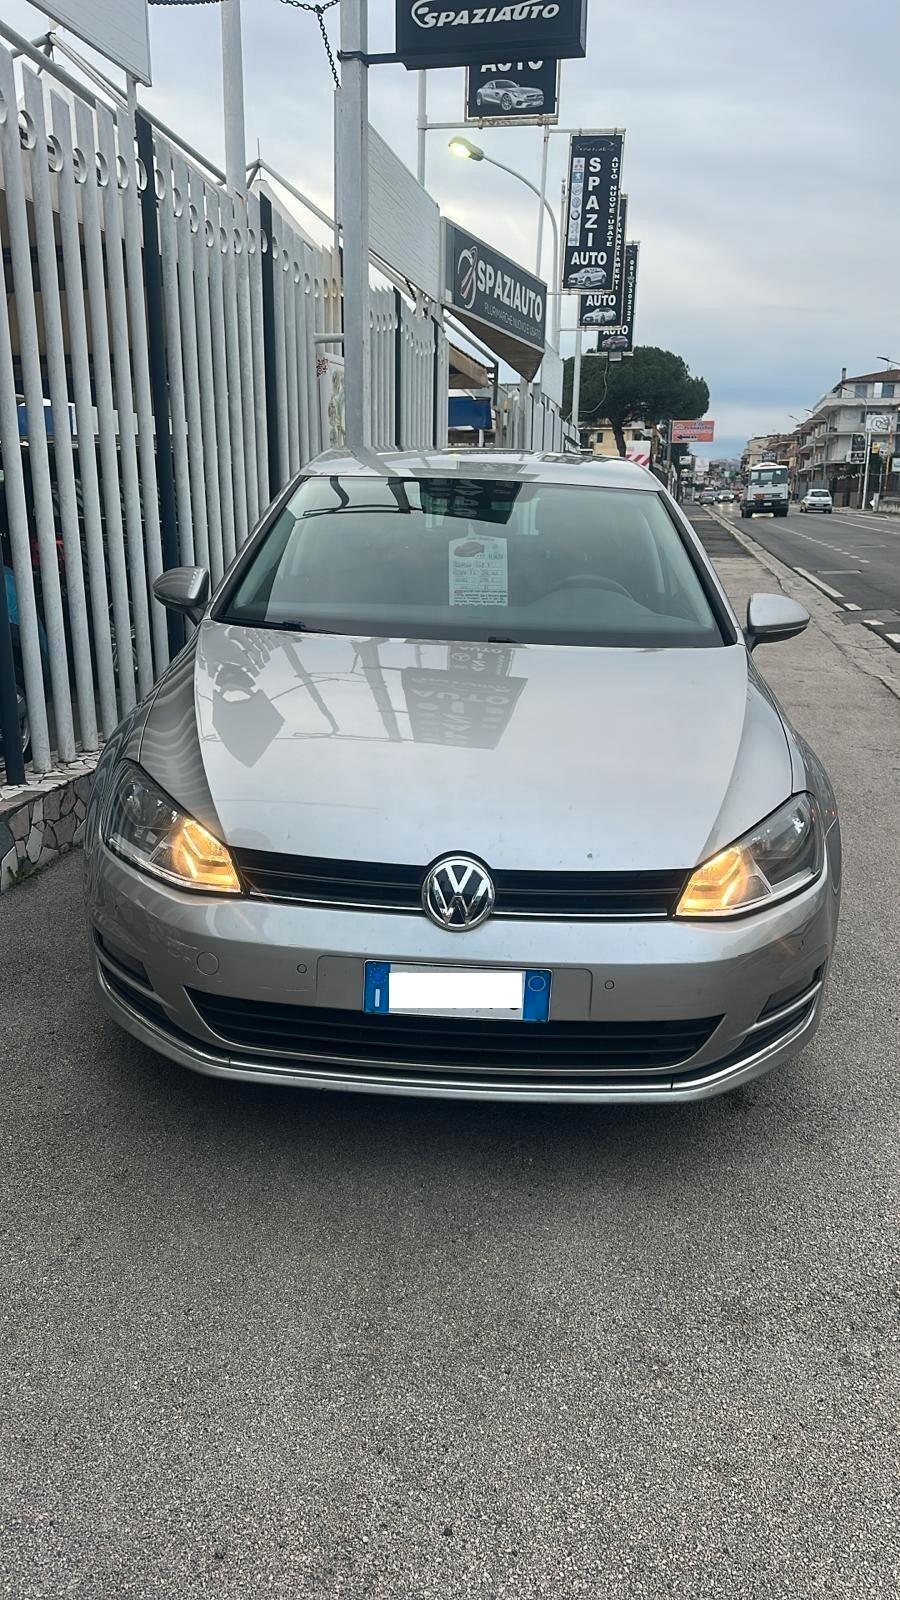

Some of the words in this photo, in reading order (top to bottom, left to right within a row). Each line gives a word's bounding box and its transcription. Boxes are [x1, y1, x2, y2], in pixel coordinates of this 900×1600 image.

[417, 3, 560, 28] SPAZIAUTO
[611, 156, 620, 180] AUTO
[585, 157, 601, 247] SPAZI
[570, 251, 608, 266] AUTO
[476, 259, 543, 323] SPAZIAUTO
[586, 294, 617, 307] AUTO
